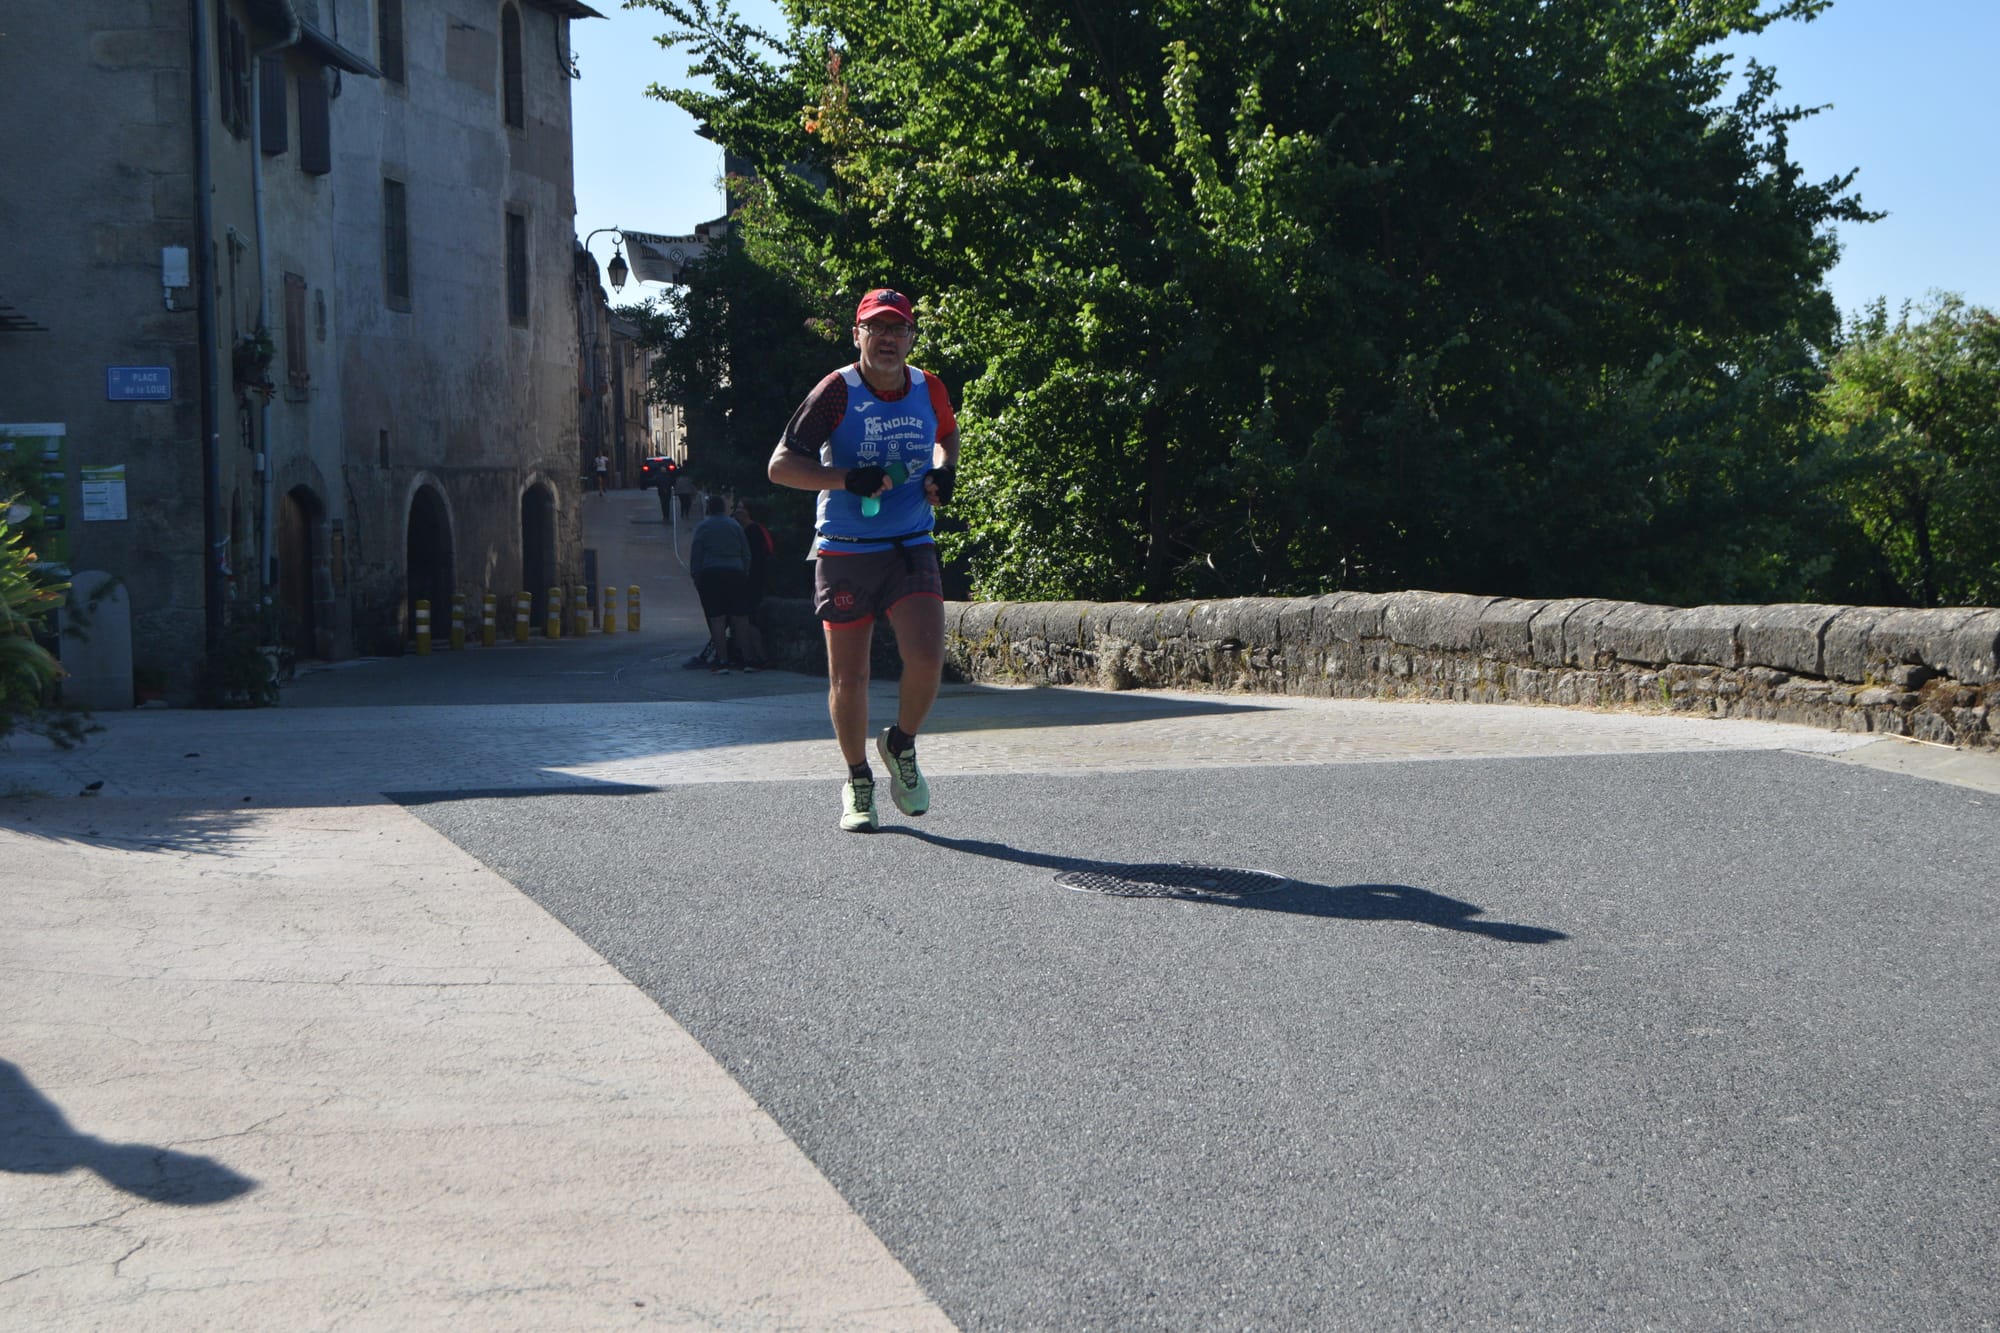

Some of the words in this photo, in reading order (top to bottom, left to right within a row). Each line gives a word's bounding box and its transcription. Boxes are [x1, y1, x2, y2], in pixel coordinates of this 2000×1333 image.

[627, 232, 683, 244] MAISON
[688, 235, 704, 244] DE
[132, 372, 158, 383] PLACE
[834, 594, 854, 607] CTC
